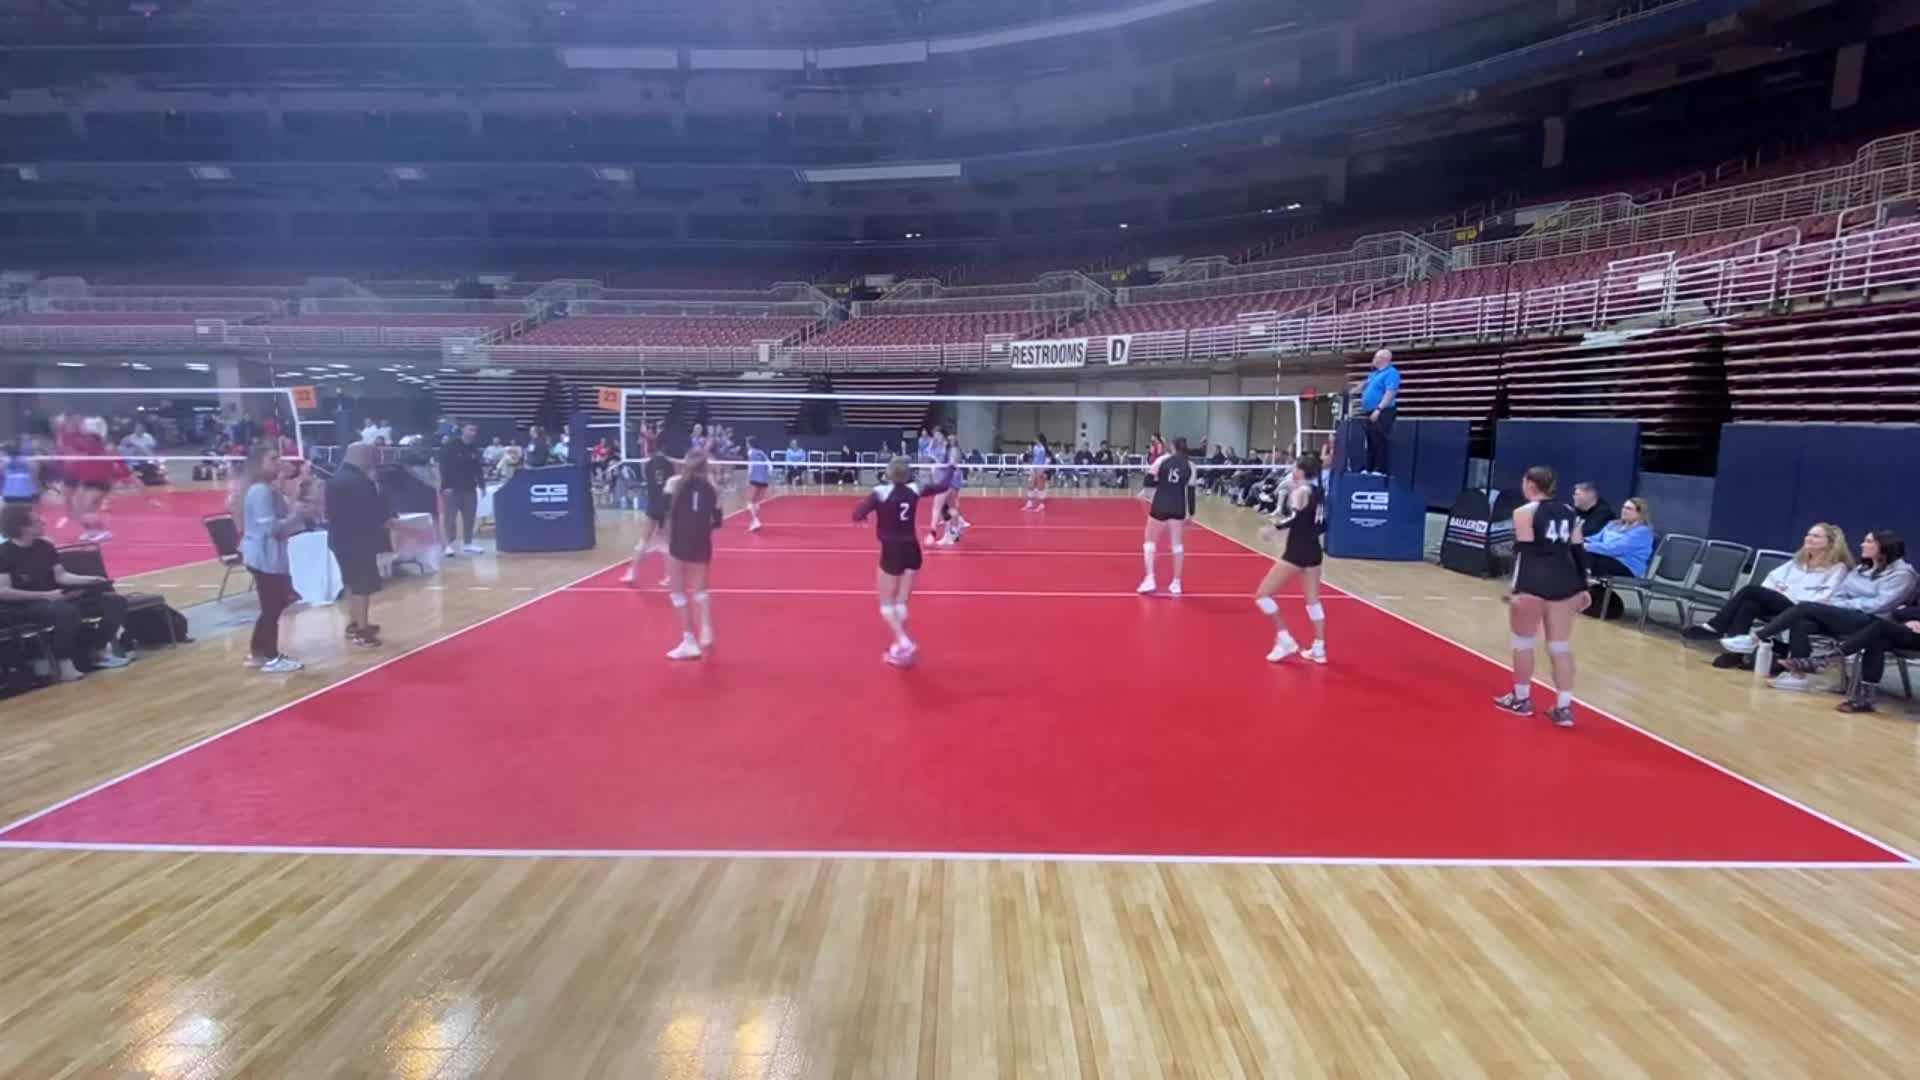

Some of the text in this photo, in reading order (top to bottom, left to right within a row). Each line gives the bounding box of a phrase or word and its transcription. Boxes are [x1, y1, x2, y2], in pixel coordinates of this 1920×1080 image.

[1011, 342, 1084, 365] RESTROOMS
[1111, 339, 1126, 361] D
[1351, 491, 1389, 504] CG
[900, 503, 910, 521] 2
[1544, 519, 1570, 543] 44
